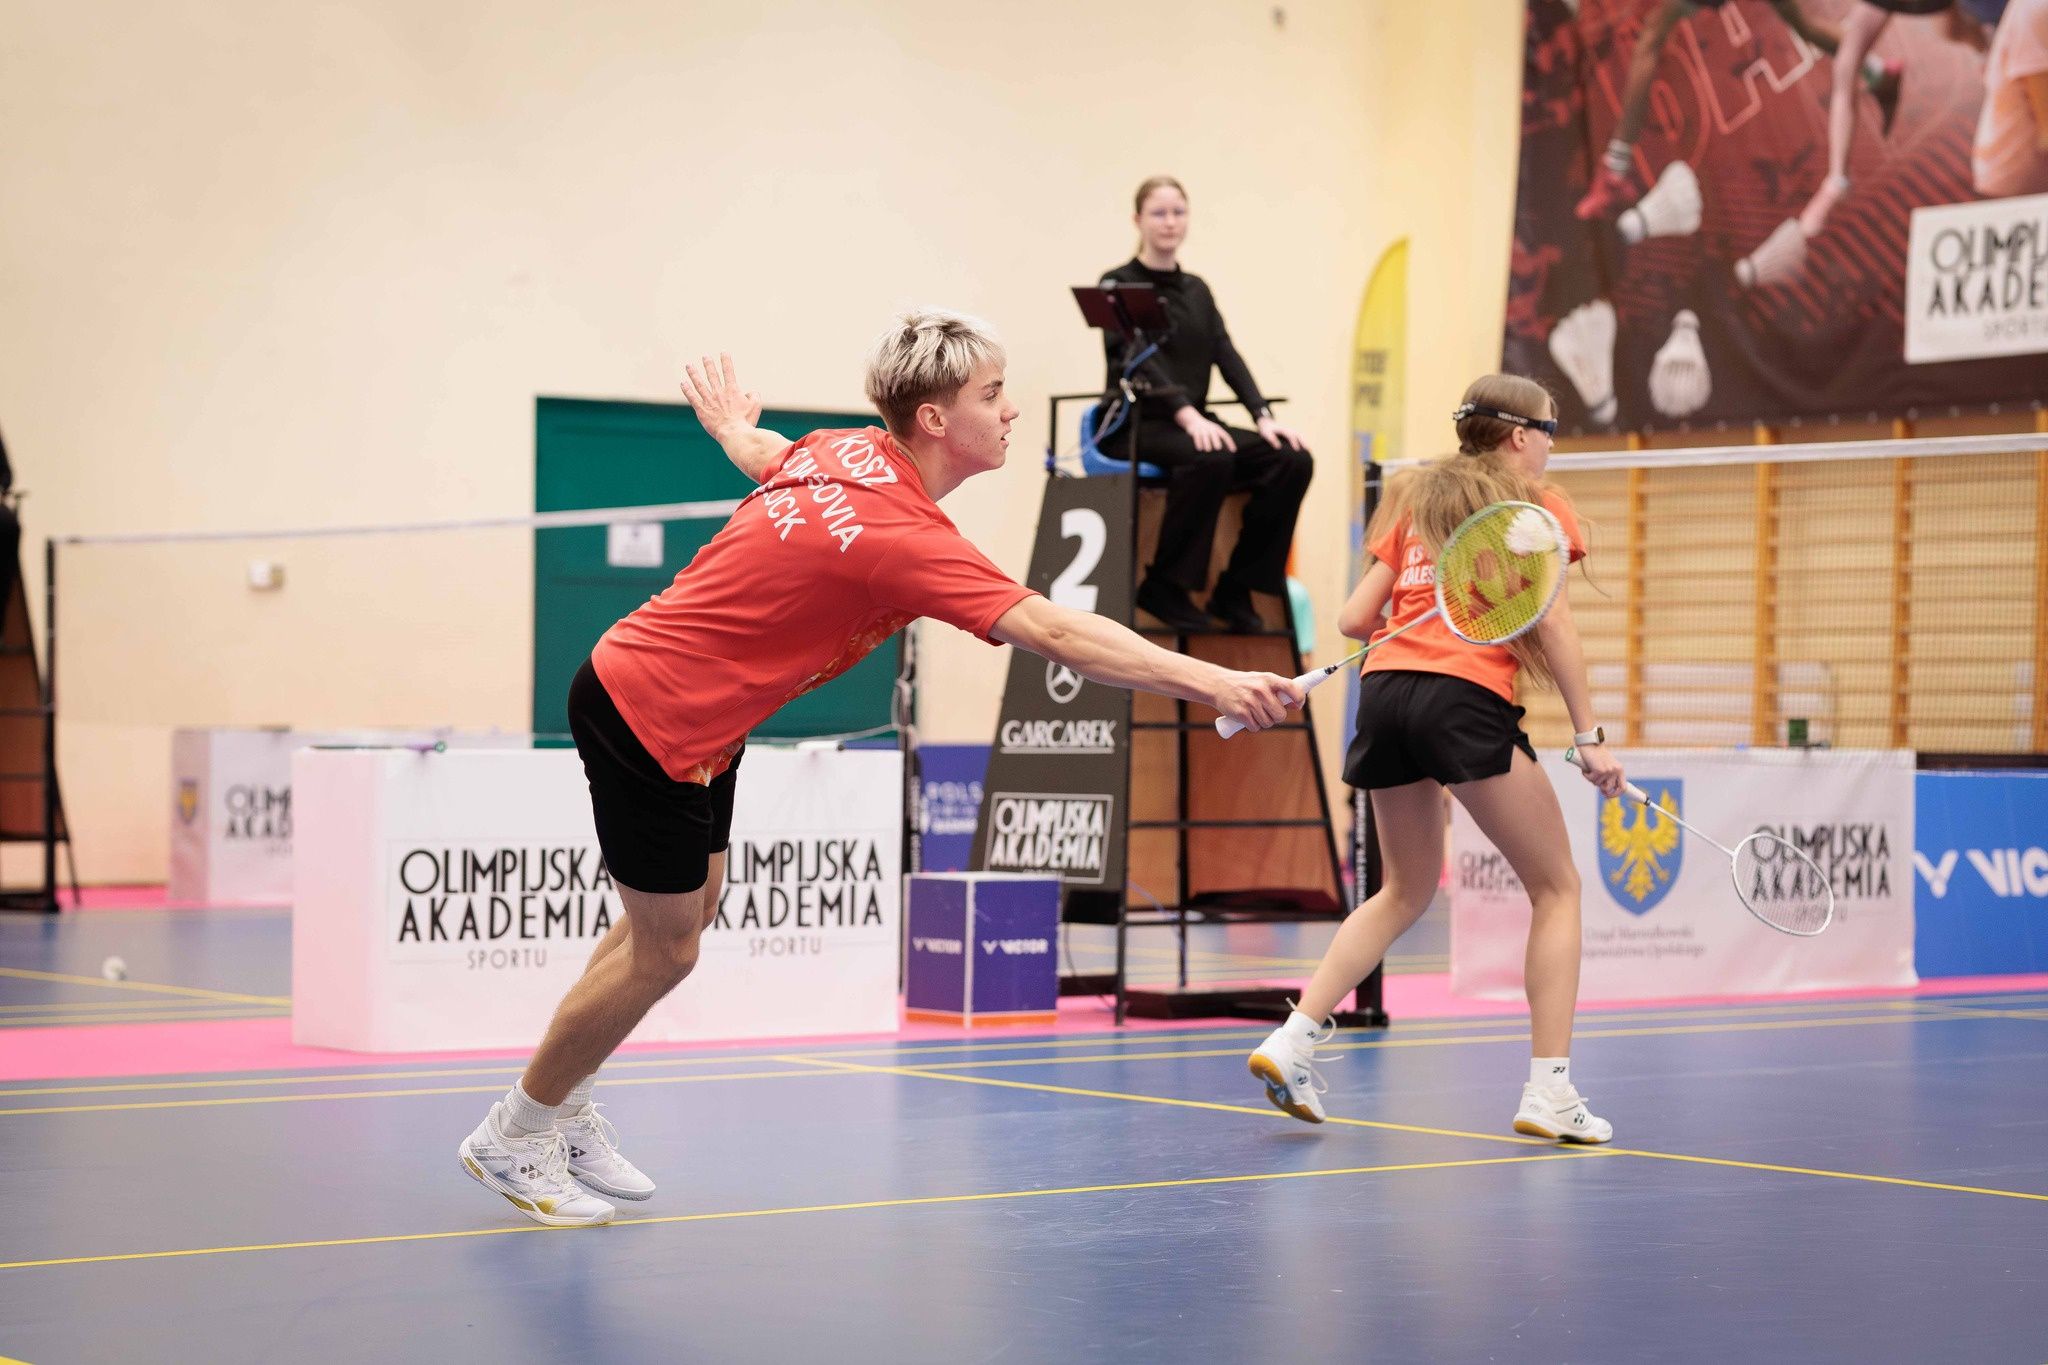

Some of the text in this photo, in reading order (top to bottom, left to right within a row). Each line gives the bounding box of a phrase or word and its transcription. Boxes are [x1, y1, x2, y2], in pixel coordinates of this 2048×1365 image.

[1050, 508, 1107, 613] 2
[1001, 719, 1118, 748] GARCAREK
[995, 799, 1104, 837] OLIMPIJSKA
[727, 839, 882, 884] LIMPIJSKA
[989, 831, 1102, 870] AKADEMIA
[1751, 824, 1891, 862] OLIMPIJSKA
[400, 848, 613, 894] OLIMPIJSKA
[1751, 862, 1891, 900] AKADEMIA
[399, 895, 612, 941] AKADEMIA
[714, 884, 882, 929] KADEMIA
[466, 948, 548, 970] SPORTU
[750, 936, 822, 957] SPORTU
